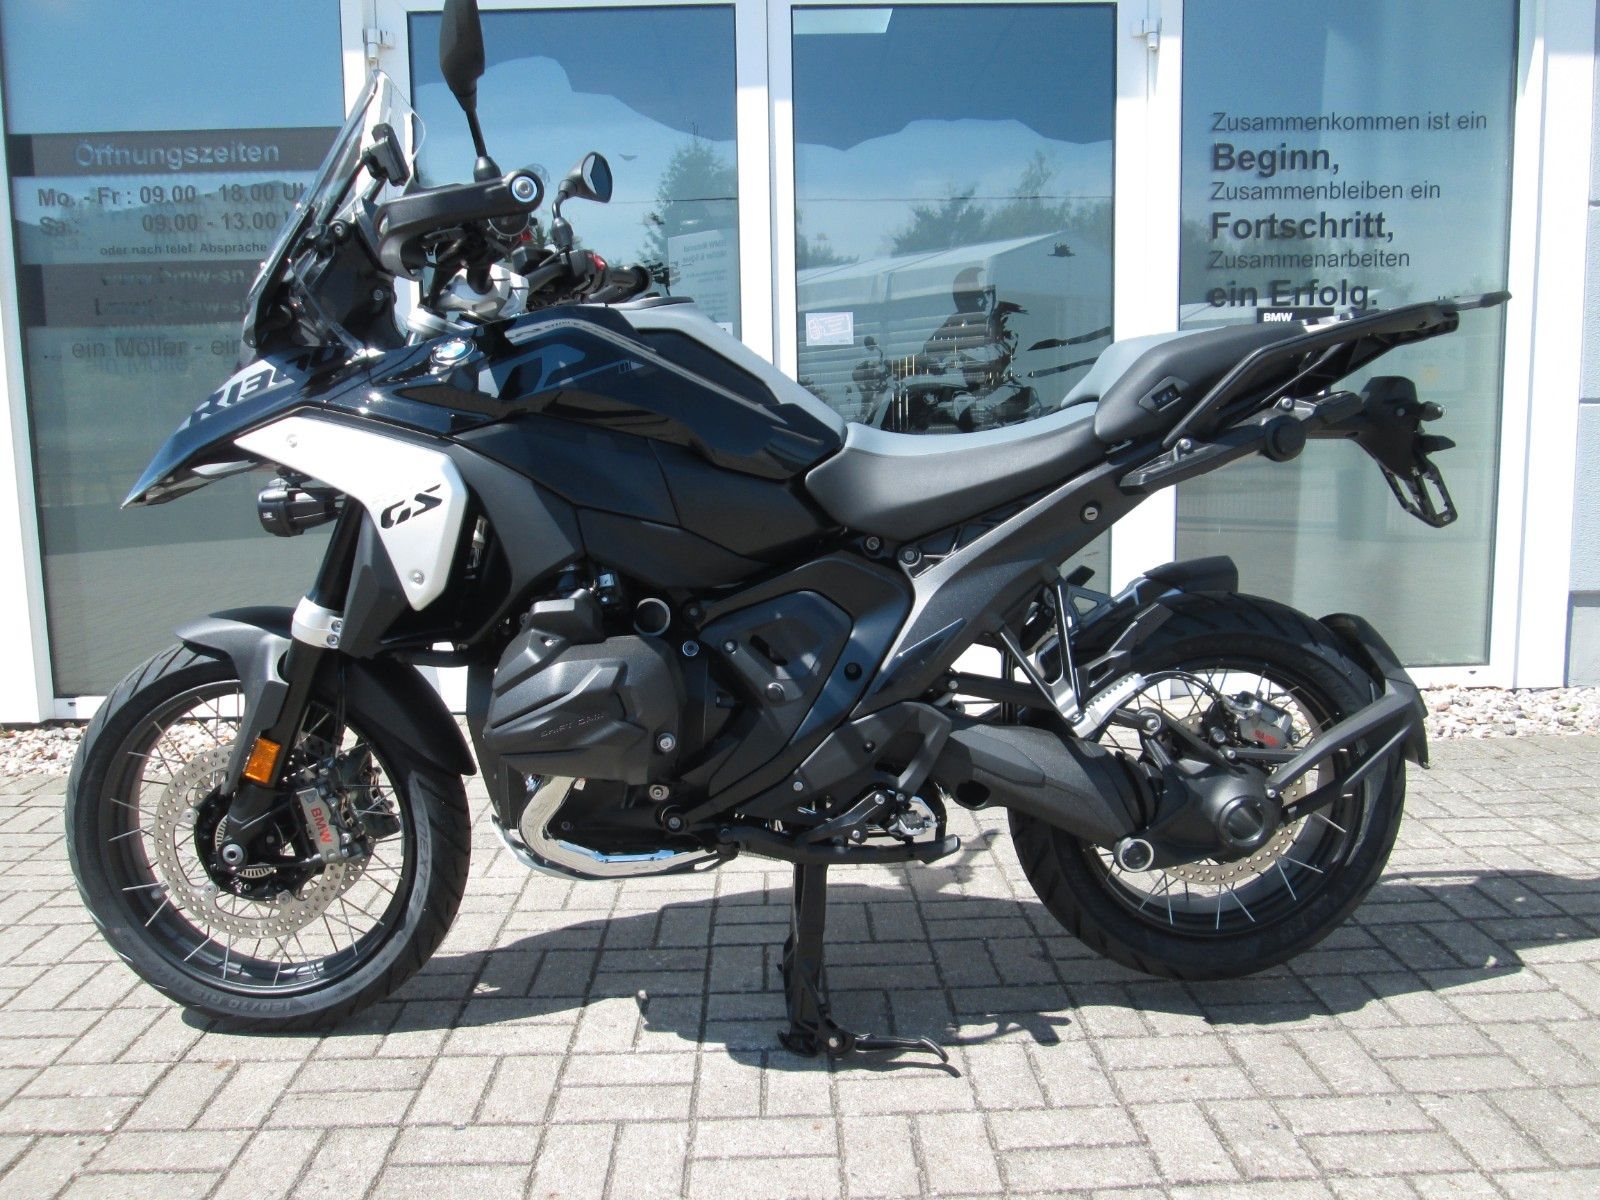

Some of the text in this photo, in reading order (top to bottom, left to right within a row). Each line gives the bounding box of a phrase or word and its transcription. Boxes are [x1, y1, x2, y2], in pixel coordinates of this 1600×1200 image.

[1211, 111, 1488, 132] Zusammenkommen ist ein
[74, 139, 280, 170] Öffnungszeiten
[1212, 142, 1340, 179] Beginn,
[140, 185, 196, 205] 09.00
[220, 183, 274, 202] 18.00
[1210, 180, 1441, 201] Zusammenbleiben ein
[142, 213, 198, 232] 09.00
[221, 211, 277, 231] 13.00
[1211, 211, 1394, 243] Fortschritt,
[1208, 249, 1410, 270] Zusammenarbeiten
[1206, 279, 1378, 311] ein Erfolg.
[1263, 312, 1293, 323] BMW
[381, 483, 443, 529] GS
[310, 807, 333, 843] BMW
